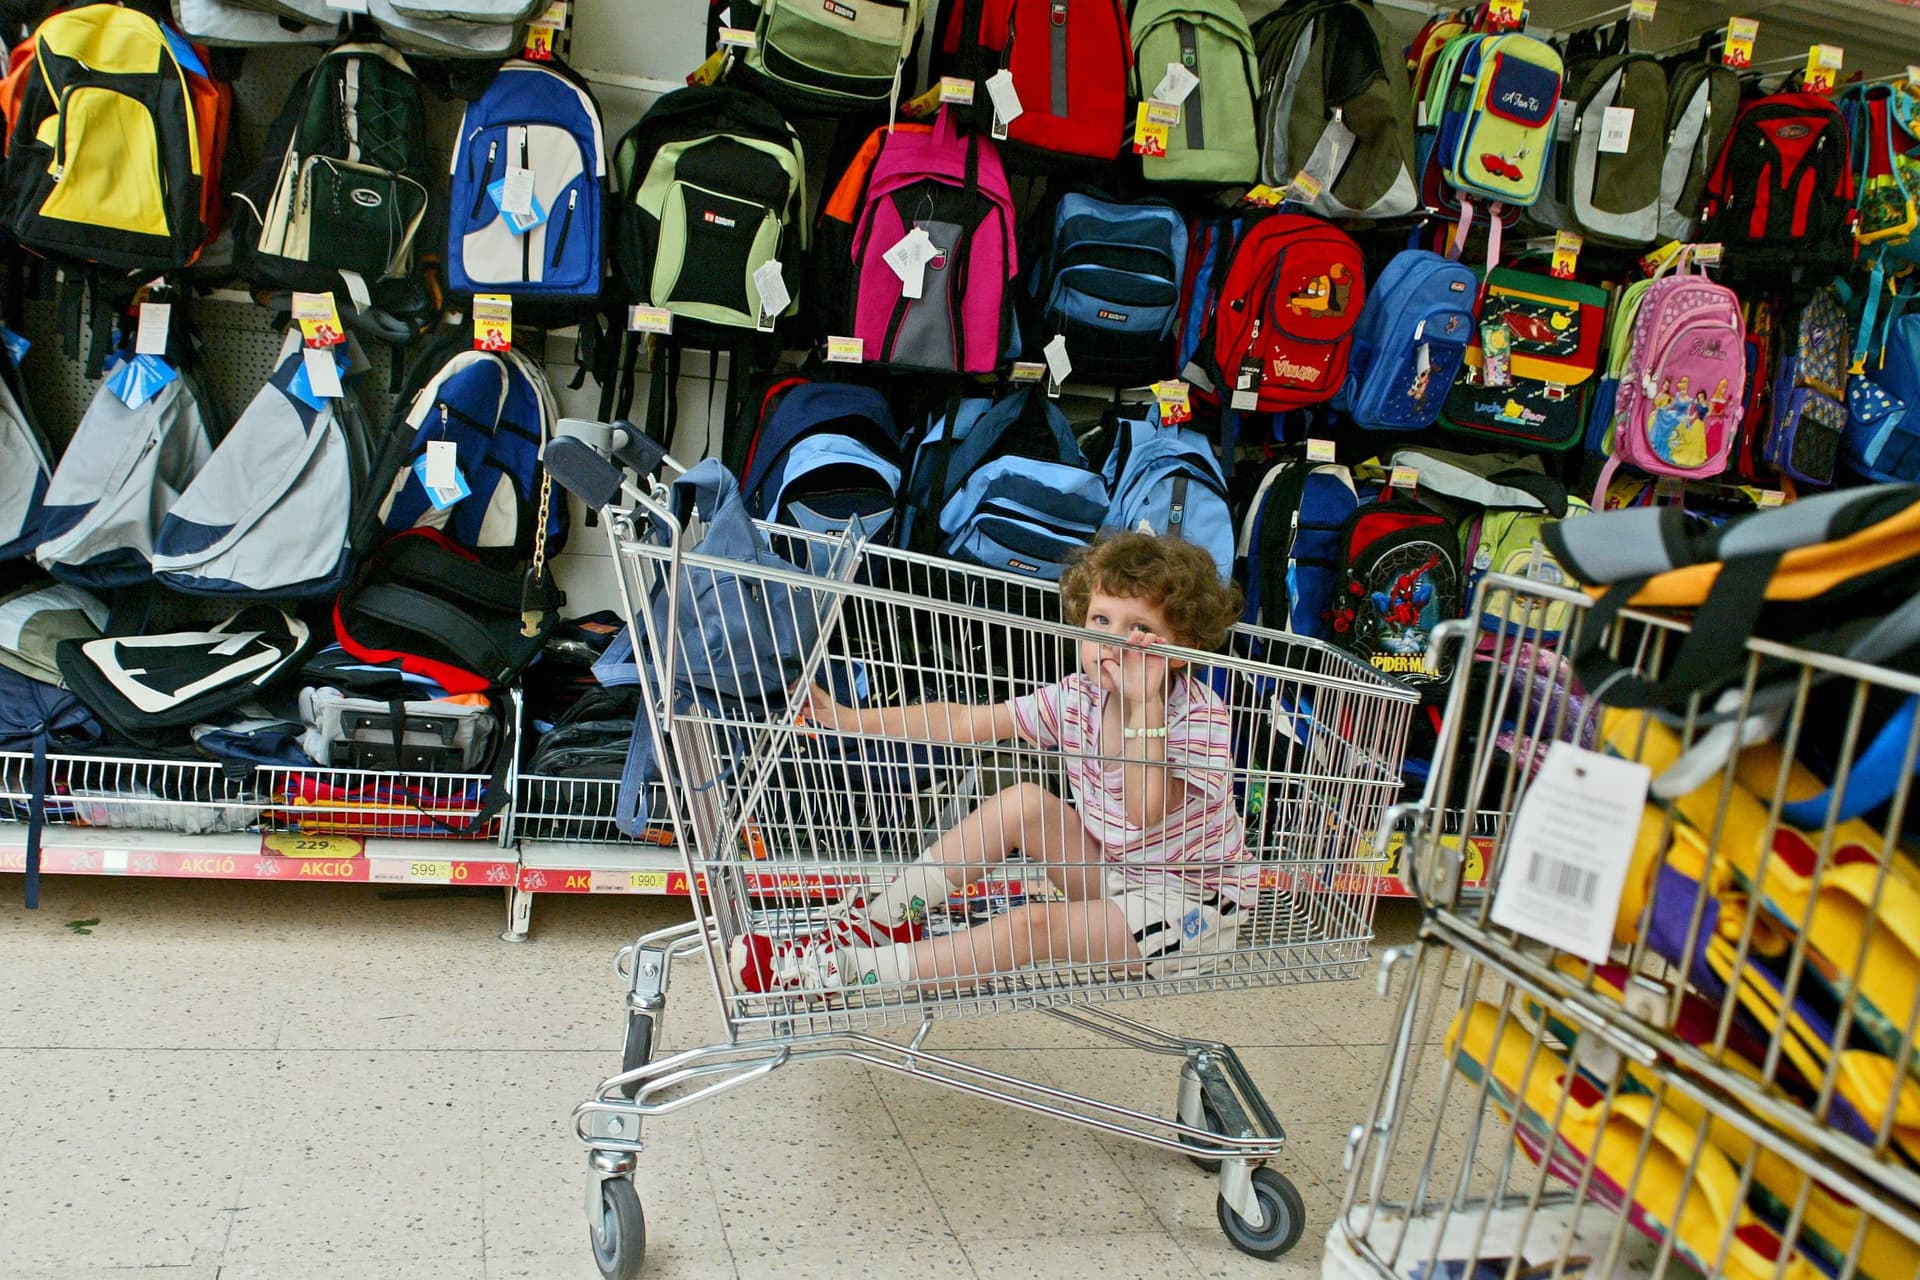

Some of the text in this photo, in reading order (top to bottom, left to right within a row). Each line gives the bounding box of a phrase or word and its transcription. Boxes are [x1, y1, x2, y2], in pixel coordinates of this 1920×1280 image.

[296, 840, 328, 851] 229
[180, 856, 235, 873] AKCIÓ
[300, 861, 353, 877] AKCIÓ
